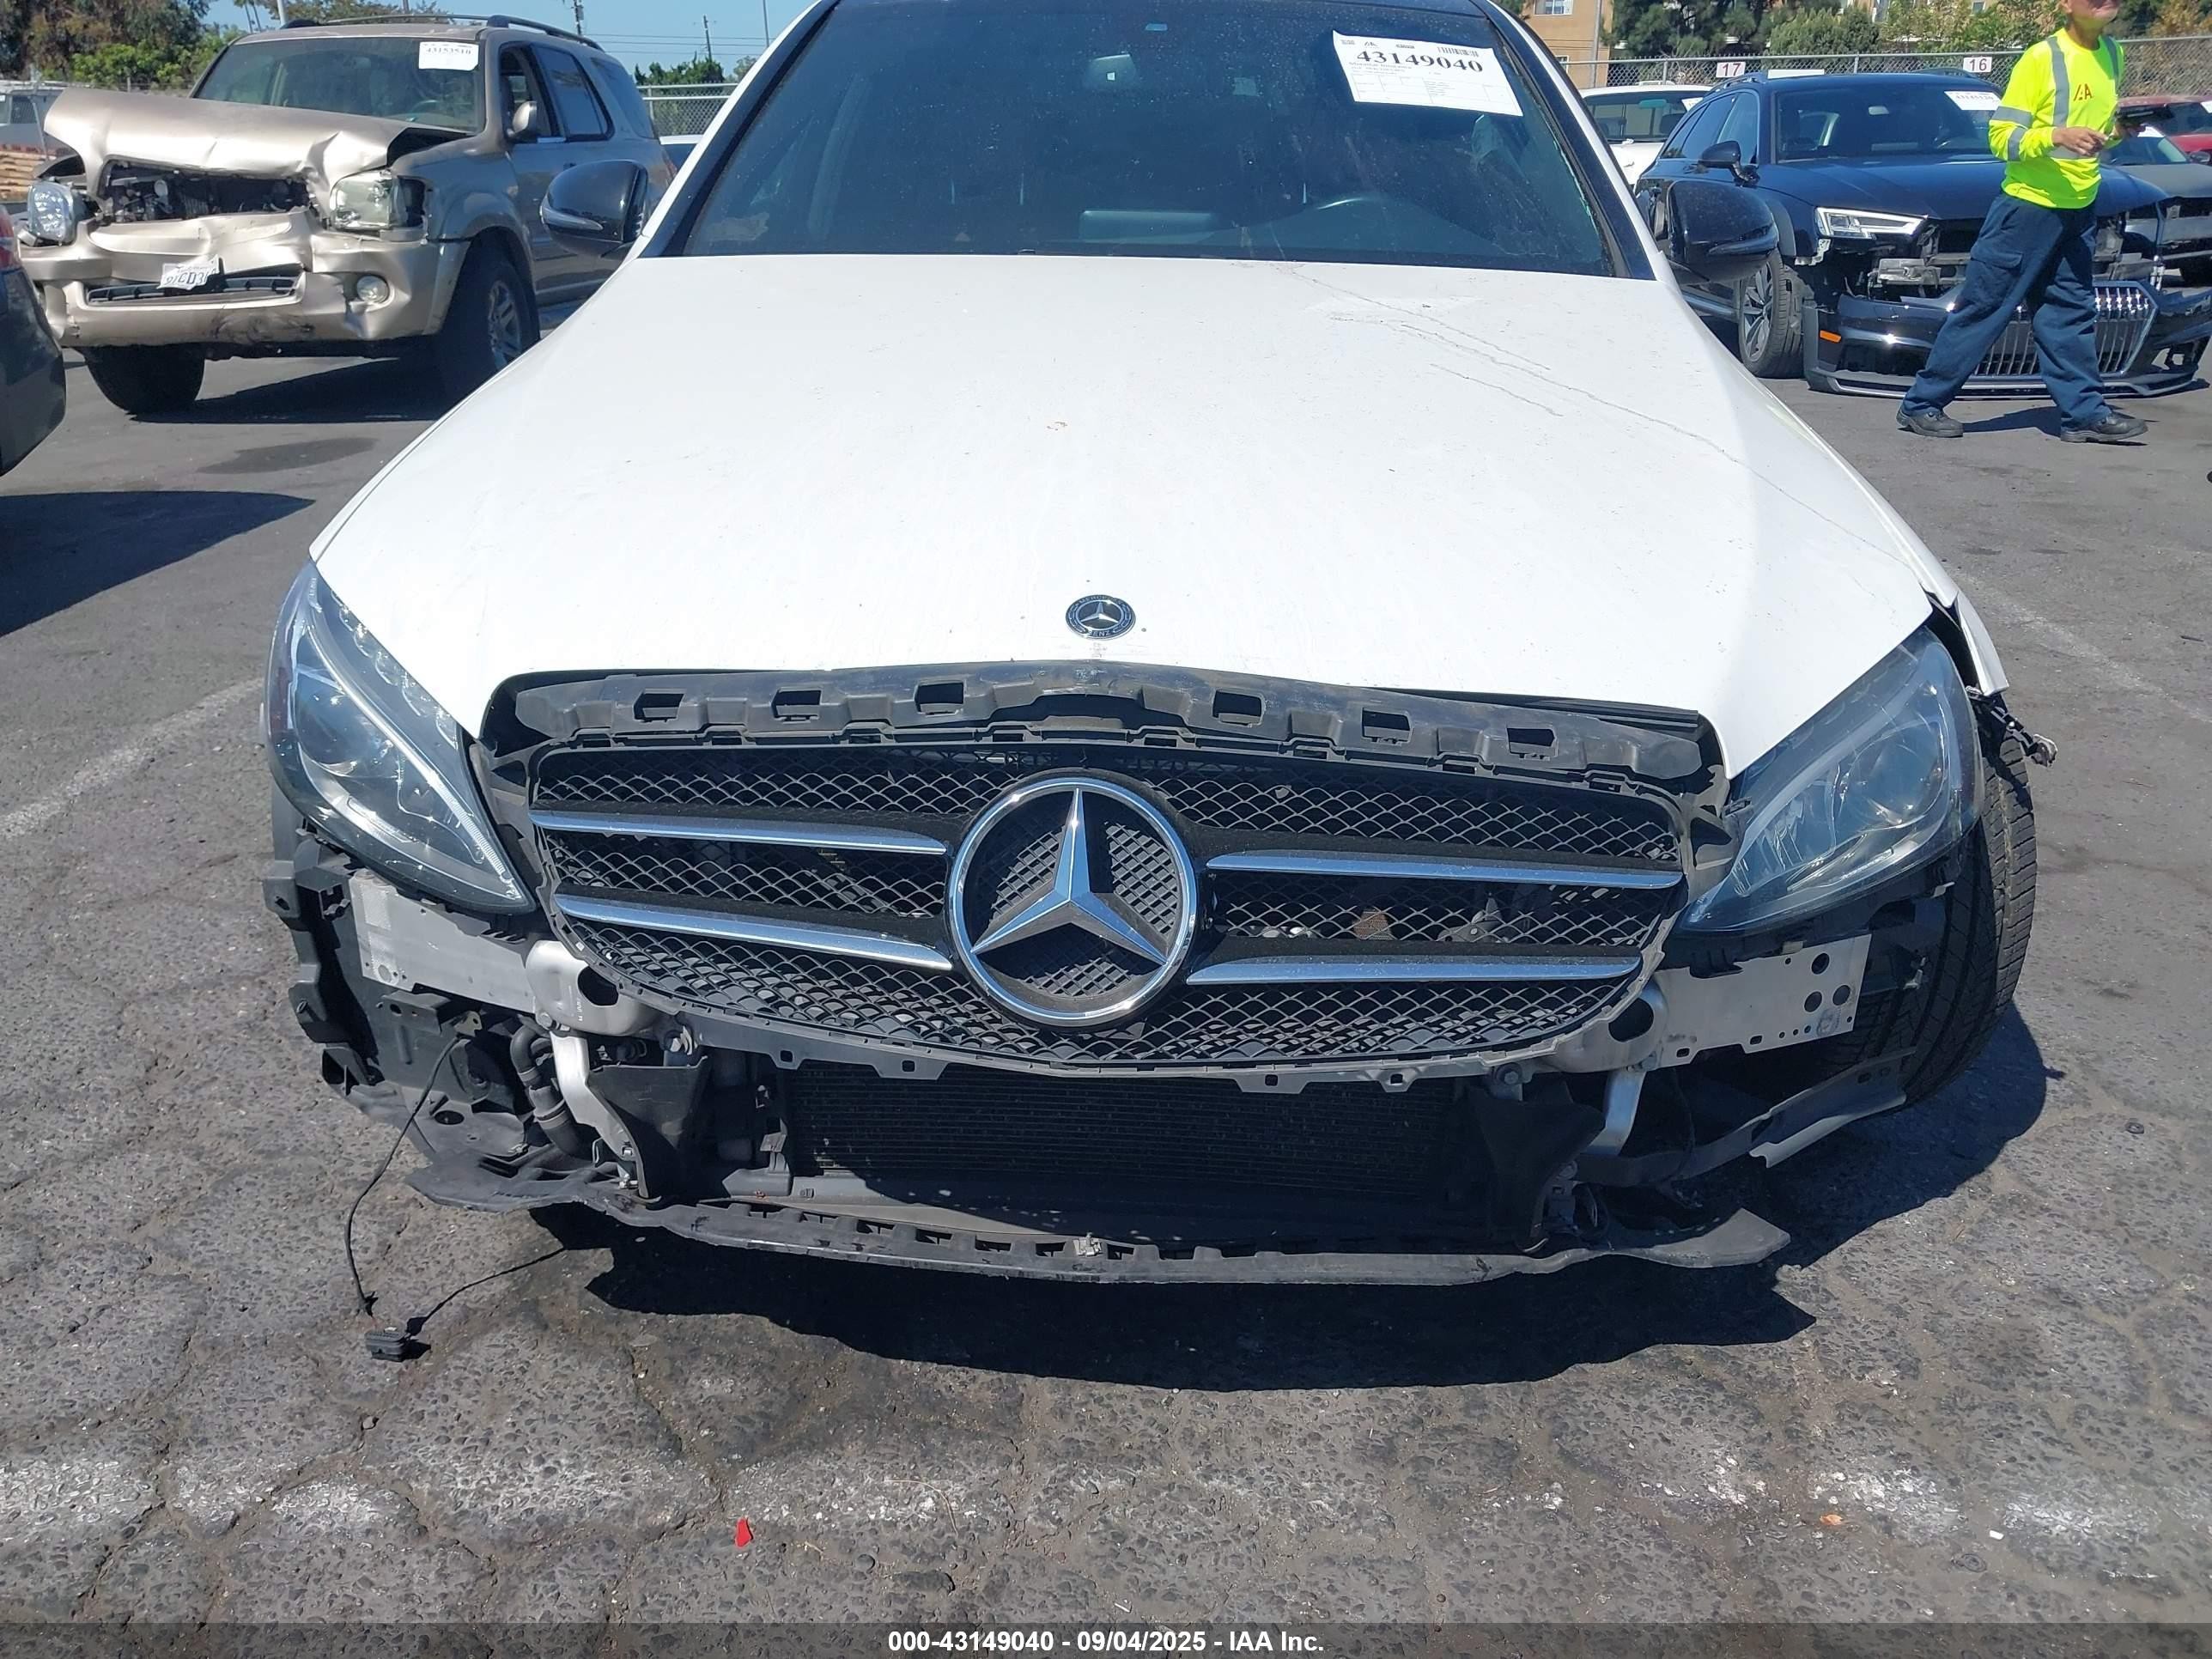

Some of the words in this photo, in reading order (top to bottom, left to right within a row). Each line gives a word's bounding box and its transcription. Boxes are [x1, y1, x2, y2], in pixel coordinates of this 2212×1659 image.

[1357, 50, 1484, 74] 43149040
[1969, 58, 1987, 71] 16
[1723, 63, 1741, 76] 17
